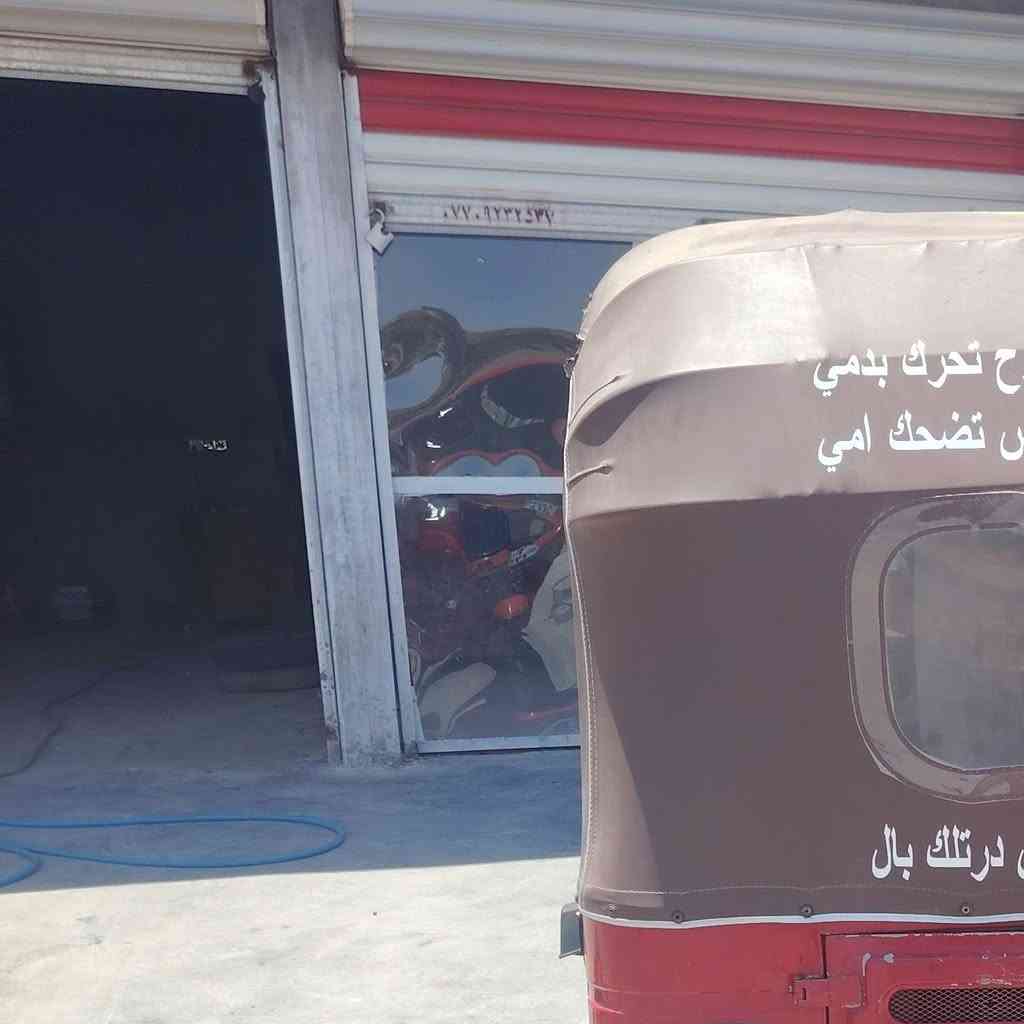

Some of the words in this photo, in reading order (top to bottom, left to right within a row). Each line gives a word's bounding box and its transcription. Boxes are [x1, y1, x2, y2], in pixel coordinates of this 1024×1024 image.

[813, 348, 888, 396] بدمي
[902, 339, 983, 388] تحرك
[817, 411, 872, 472] امي
[889, 410, 986, 451] تضحك
[871, 823, 913, 881] بال
[926, 824, 1004, 881] درتلك
